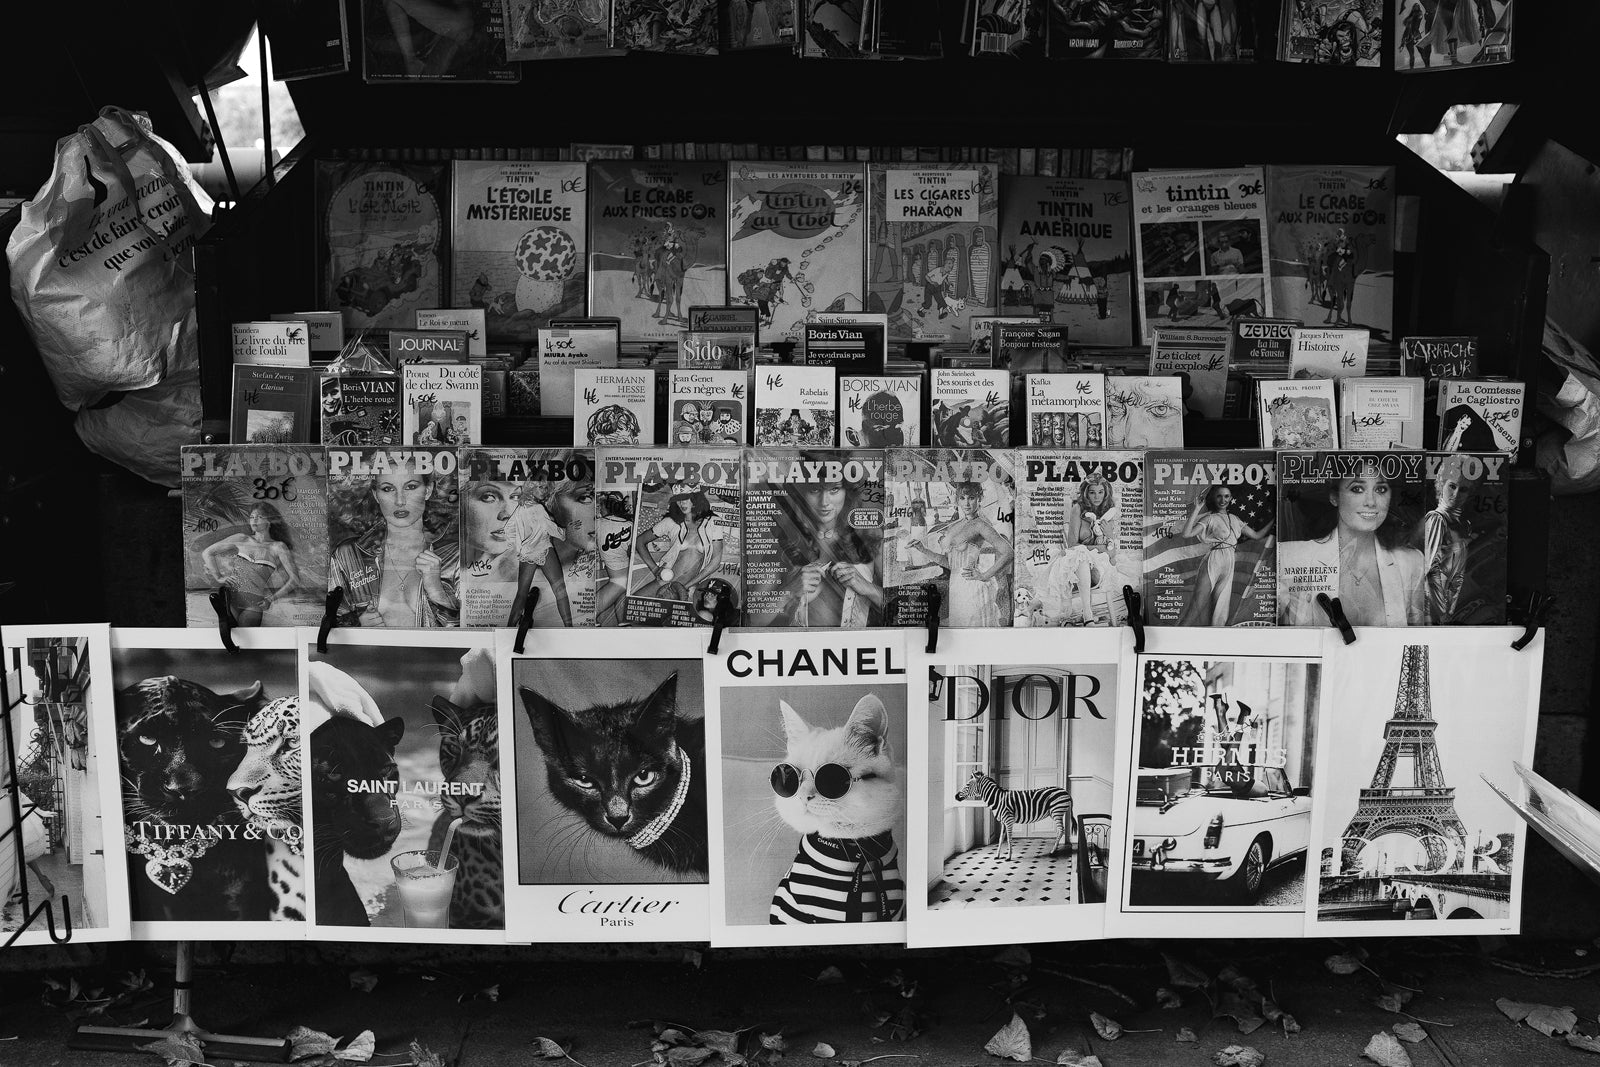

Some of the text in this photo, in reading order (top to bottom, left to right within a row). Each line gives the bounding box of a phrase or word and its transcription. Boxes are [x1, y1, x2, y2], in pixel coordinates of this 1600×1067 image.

[506, 176, 533, 184] TINTIN
[918, 177, 946, 185] TINTIN
[1319, 182, 1345, 190] TINTIN
[364, 181, 404, 192] TINTIN
[486, 186, 553, 205] L'ÉTOILE
[625, 187, 694, 204] LE CRABE
[757, 188, 828, 210] Tintin
[894, 188, 970, 201] LES CIGARES
[1051, 190, 1079, 198] TINTIN
[1166, 184, 1230, 202] tintin
[1141, 200, 1257, 214] et les oranges bleues
[1299, 193, 1365, 209] LE CRABE
[466, 203, 572, 222] MYSTÉRIEUSE
[602, 203, 717, 220] AUX PINCES D'OR
[902, 206, 962, 219] PHARAON
[1037, 201, 1093, 218] TINTIN
[751, 210, 838, 231] au Tibet
[1278, 209, 1386, 226] AUX PINCES D'OR
[58, 239, 93, 268] c'est
[92, 229, 113, 250] de
[146, 190, 181, 220] croir
[1020, 220, 1113, 239] AMÉRIQUE
[103, 246, 135, 272] que
[233, 326, 260, 335] Kundera
[808, 329, 837, 340] Boris
[837, 329, 863, 340] Vian
[1000, 328, 1061, 340] Françoise Sagan
[1299, 331, 1322, 342] Jacques
[234, 334, 284, 346] Le livre du
[1159, 333, 1227, 342] William Burroughs
[234, 344, 287, 356] et de l'oubli
[397, 338, 460, 352] JOURNAL
[1000, 339, 1061, 349] Bonjour tristesse
[1299, 340, 1341, 353] Histoires
[567, 352, 589, 360] Ayako
[682, 340, 721, 361] Sido
[808, 351, 866, 361] Je voudrais pas
[1156, 350, 1201, 361] Le ticket
[1250, 348, 1260, 358] de
[1155, 361, 1173, 371] qui
[1340, 352, 1357, 368] 4€
[251, 371, 272, 380] Stefan
[405, 371, 431, 379] Proust
[440, 367, 480, 379] Du côté
[673, 374, 713, 384] Jean Genet
[937, 371, 950, 379] John
[405, 381, 480, 391] de chez Swann
[596, 375, 646, 385] HERMANN
[766, 374, 784, 391] 4€
[842, 379, 918, 392] BORIS VIAN
[937, 377, 995, 387] Des souris et des
[1030, 378, 1051, 386] Kafka
[342, 382, 397, 393] Boris VIAN
[617, 386, 646, 395] HESSE
[673, 383, 726, 397] Les nègres
[800, 388, 829, 397] Rabelais
[936, 386, 968, 396] hommes
[1031, 386, 1045, 397] La
[1456, 384, 1522, 395] La Comtesse
[344, 395, 395, 406] L'herbe rouge
[867, 399, 902, 411] l'herbe
[1031, 395, 1102, 408] métamorphose
[1450, 395, 1521, 406] de Cagliostro
[870, 411, 899, 422] rouge
[328, 451, 455, 476] PLAYBO
[1282, 454, 1422, 479] PLAYBOY
[605, 462, 741, 484] PLAYBOY
[748, 460, 883, 483] PLAYBOY
[1026, 461, 1143, 483] PLAYBO
[1154, 463, 1276, 485] PLAYBOY
[253, 476, 298, 502] 30€
[726, 647, 906, 678] CHANEL
[941, 673, 1108, 721] DIOR
[1206, 771, 1251, 783] PARIS
[347, 779, 485, 796] SAINT LAURENT
[390, 799, 442, 809] PARIS
[132, 820, 241, 840] TIFFANY
[243, 821, 262, 840] &
[817, 837, 840, 850] CHANEL
[557, 889, 680, 915] Cartier
[599, 916, 635, 928] Paris
